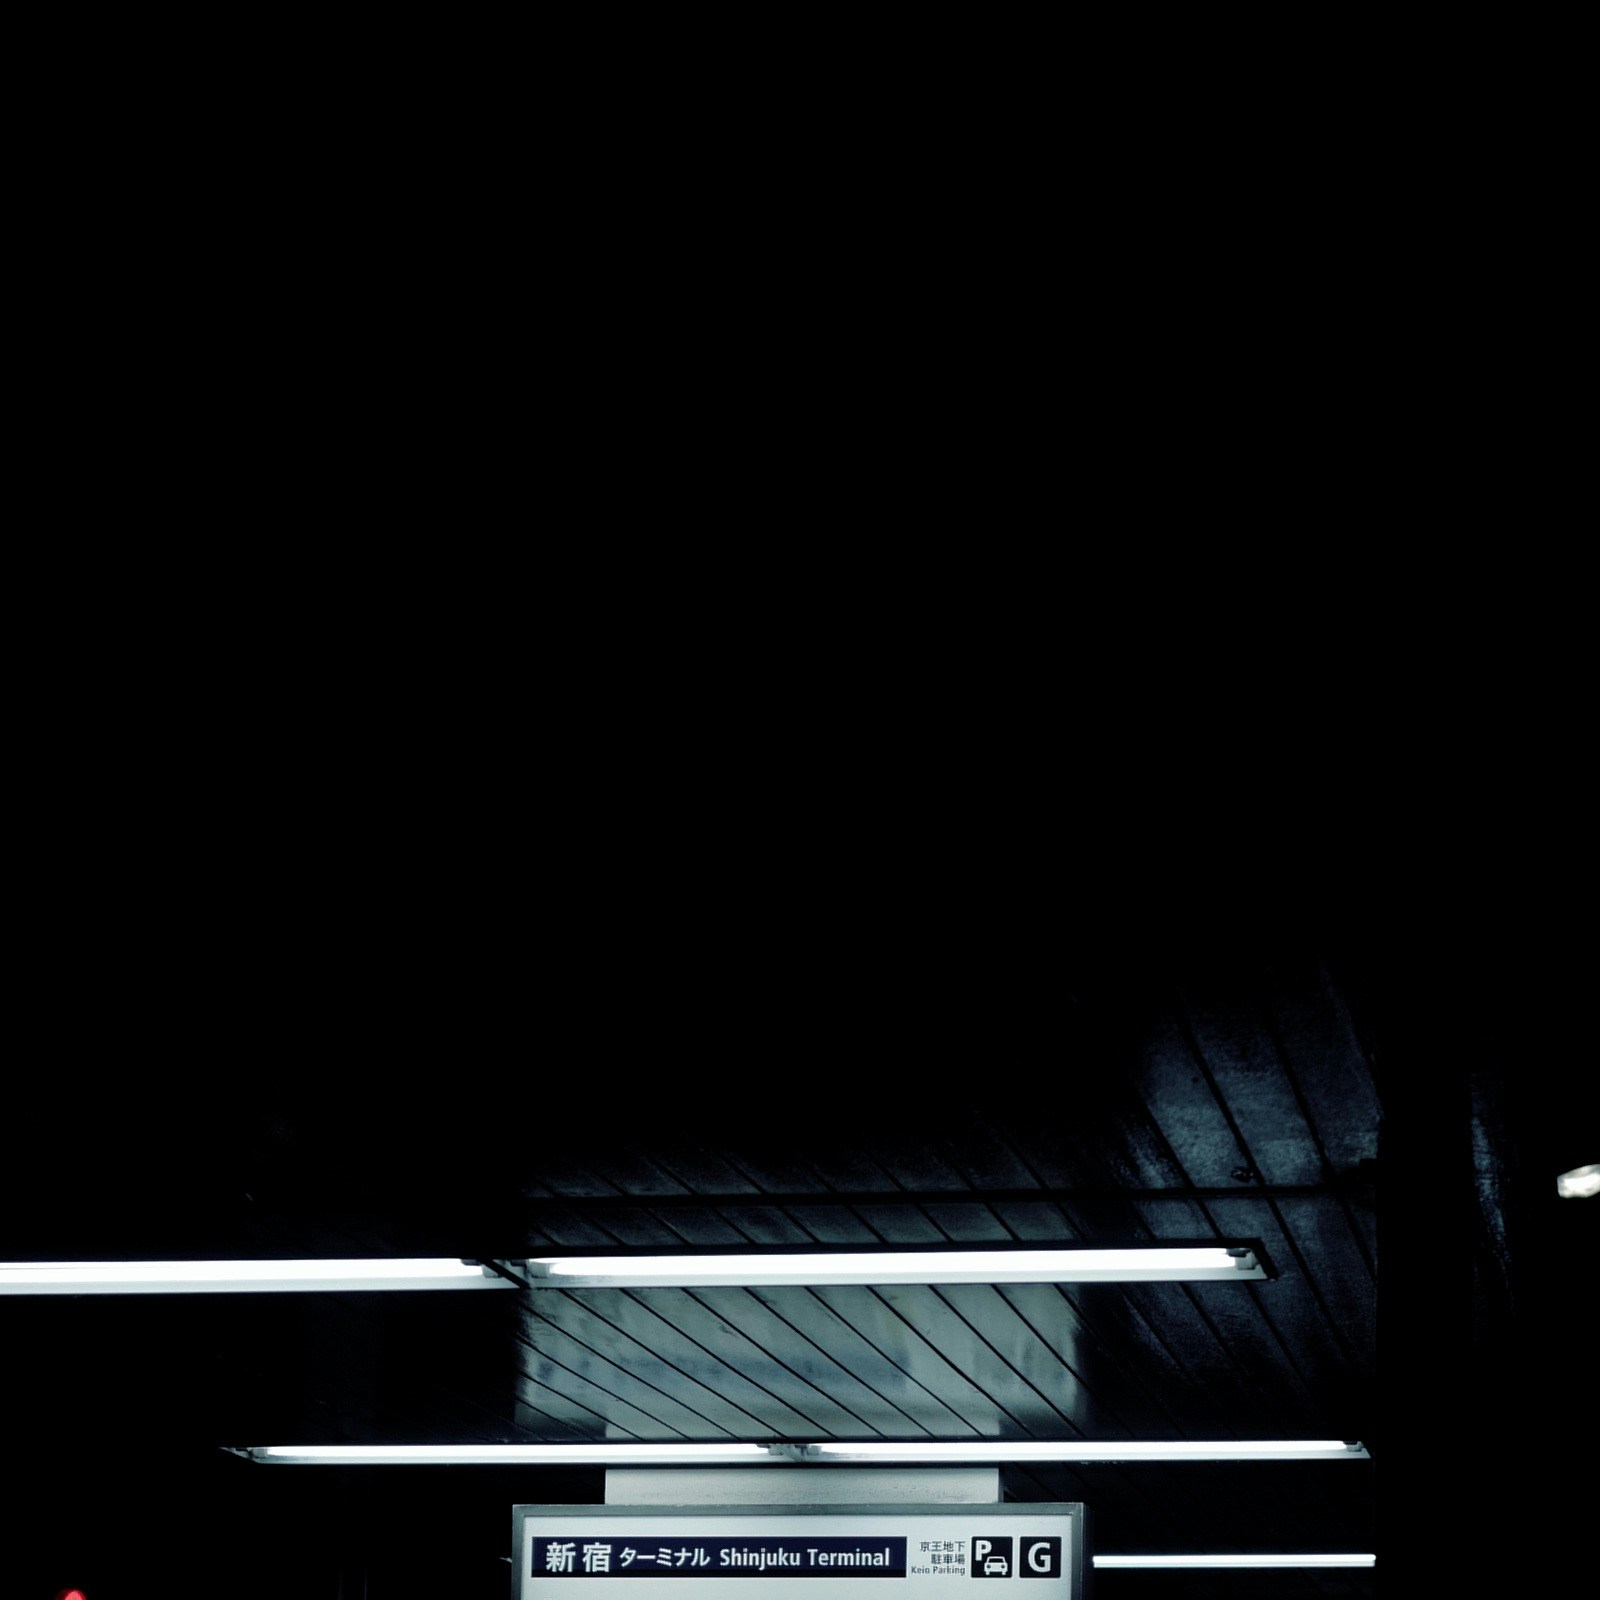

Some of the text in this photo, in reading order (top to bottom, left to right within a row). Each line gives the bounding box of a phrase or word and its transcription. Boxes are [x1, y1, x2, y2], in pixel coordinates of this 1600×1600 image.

[920, 1541, 966, 1552] 京王地下
[975, 1540, 992, 1561] P
[720, 1547, 889, 1571] Shinjuku Terminal
[931, 1553, 966, 1564] 駐車場
[1028, 1542, 1051, 1573] G
[911, 1565, 966, 1577] Keio Parking
